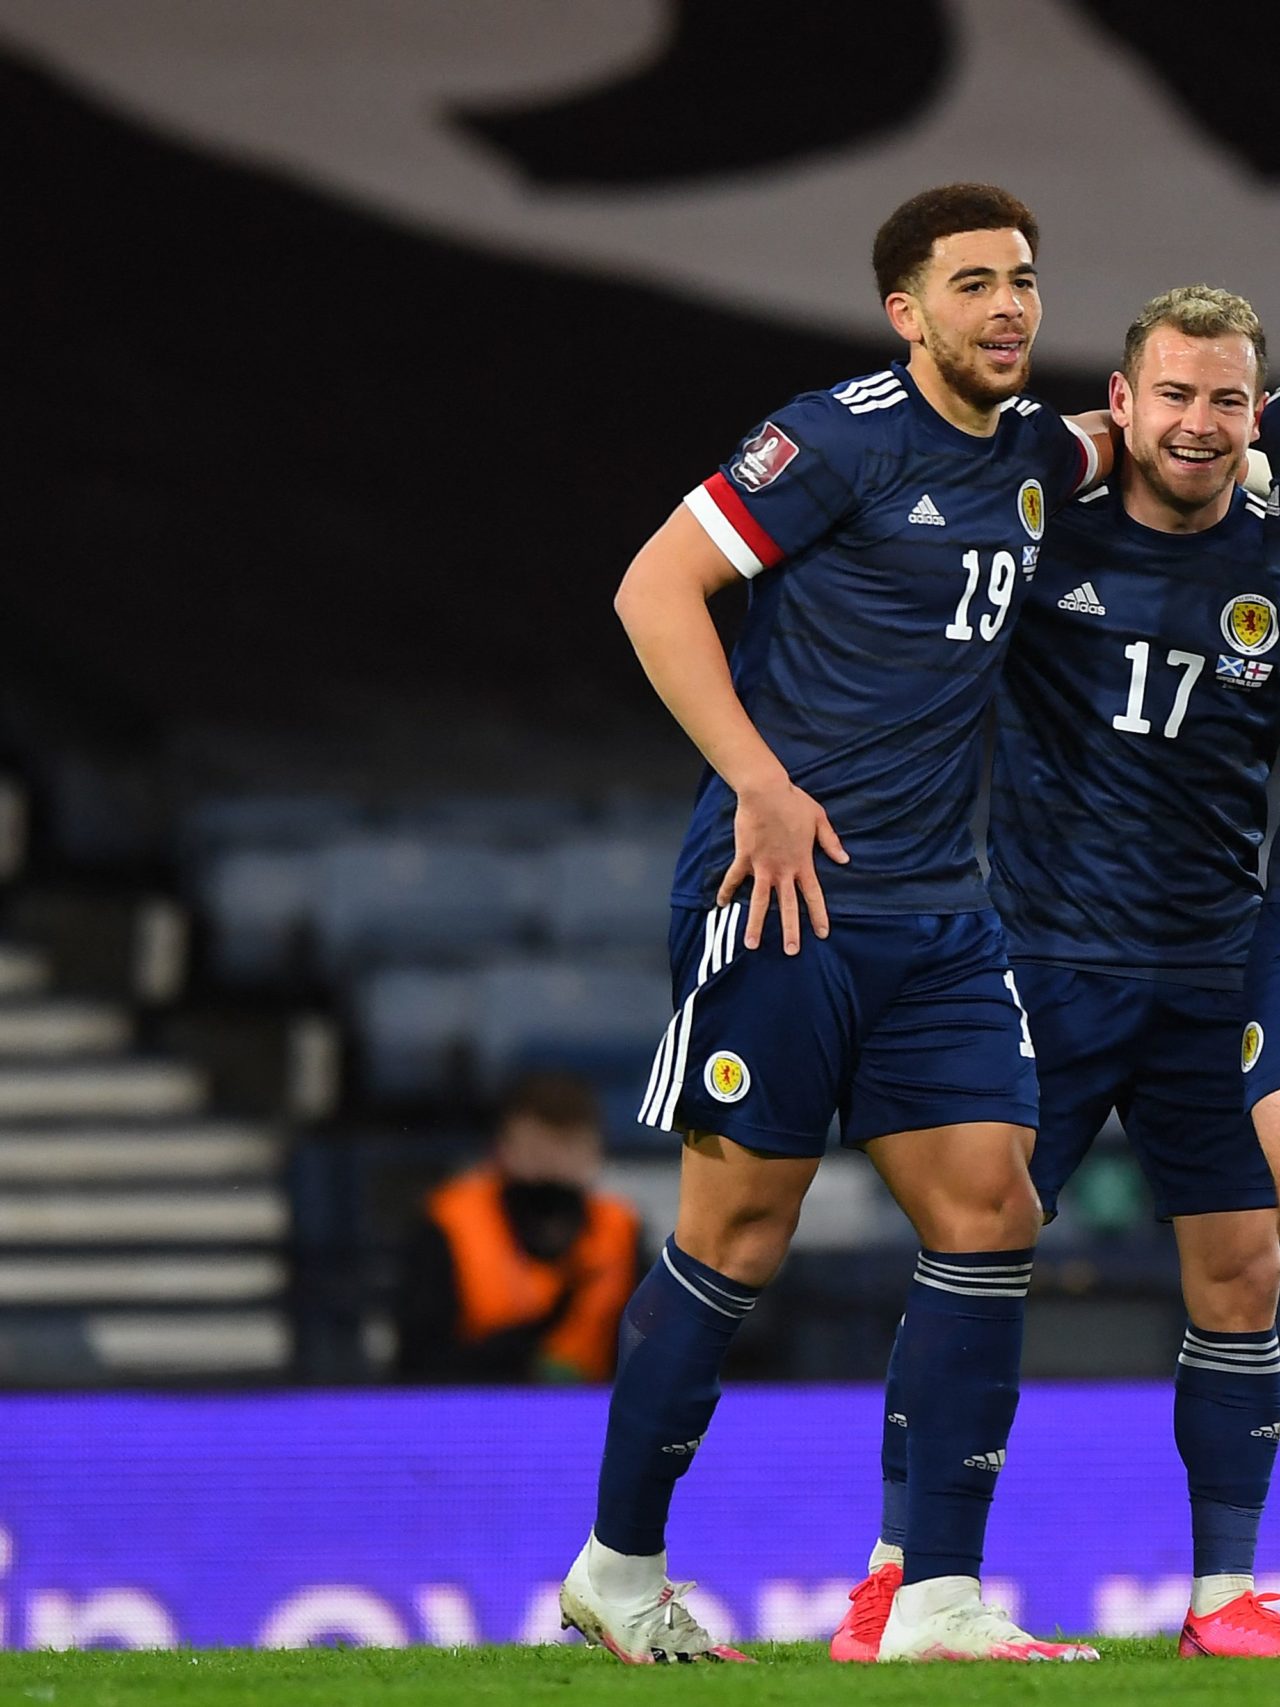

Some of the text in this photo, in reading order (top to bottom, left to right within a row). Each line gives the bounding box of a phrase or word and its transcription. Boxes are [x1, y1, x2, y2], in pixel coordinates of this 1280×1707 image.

[908, 513, 946, 527] adidas
[945, 549, 1016, 642] 19
[1057, 599, 1106, 616] adidas
[1112, 641, 1206, 739] 17
[1003, 970, 1035, 1058] 1
[963, 1459, 1003, 1473] adid
